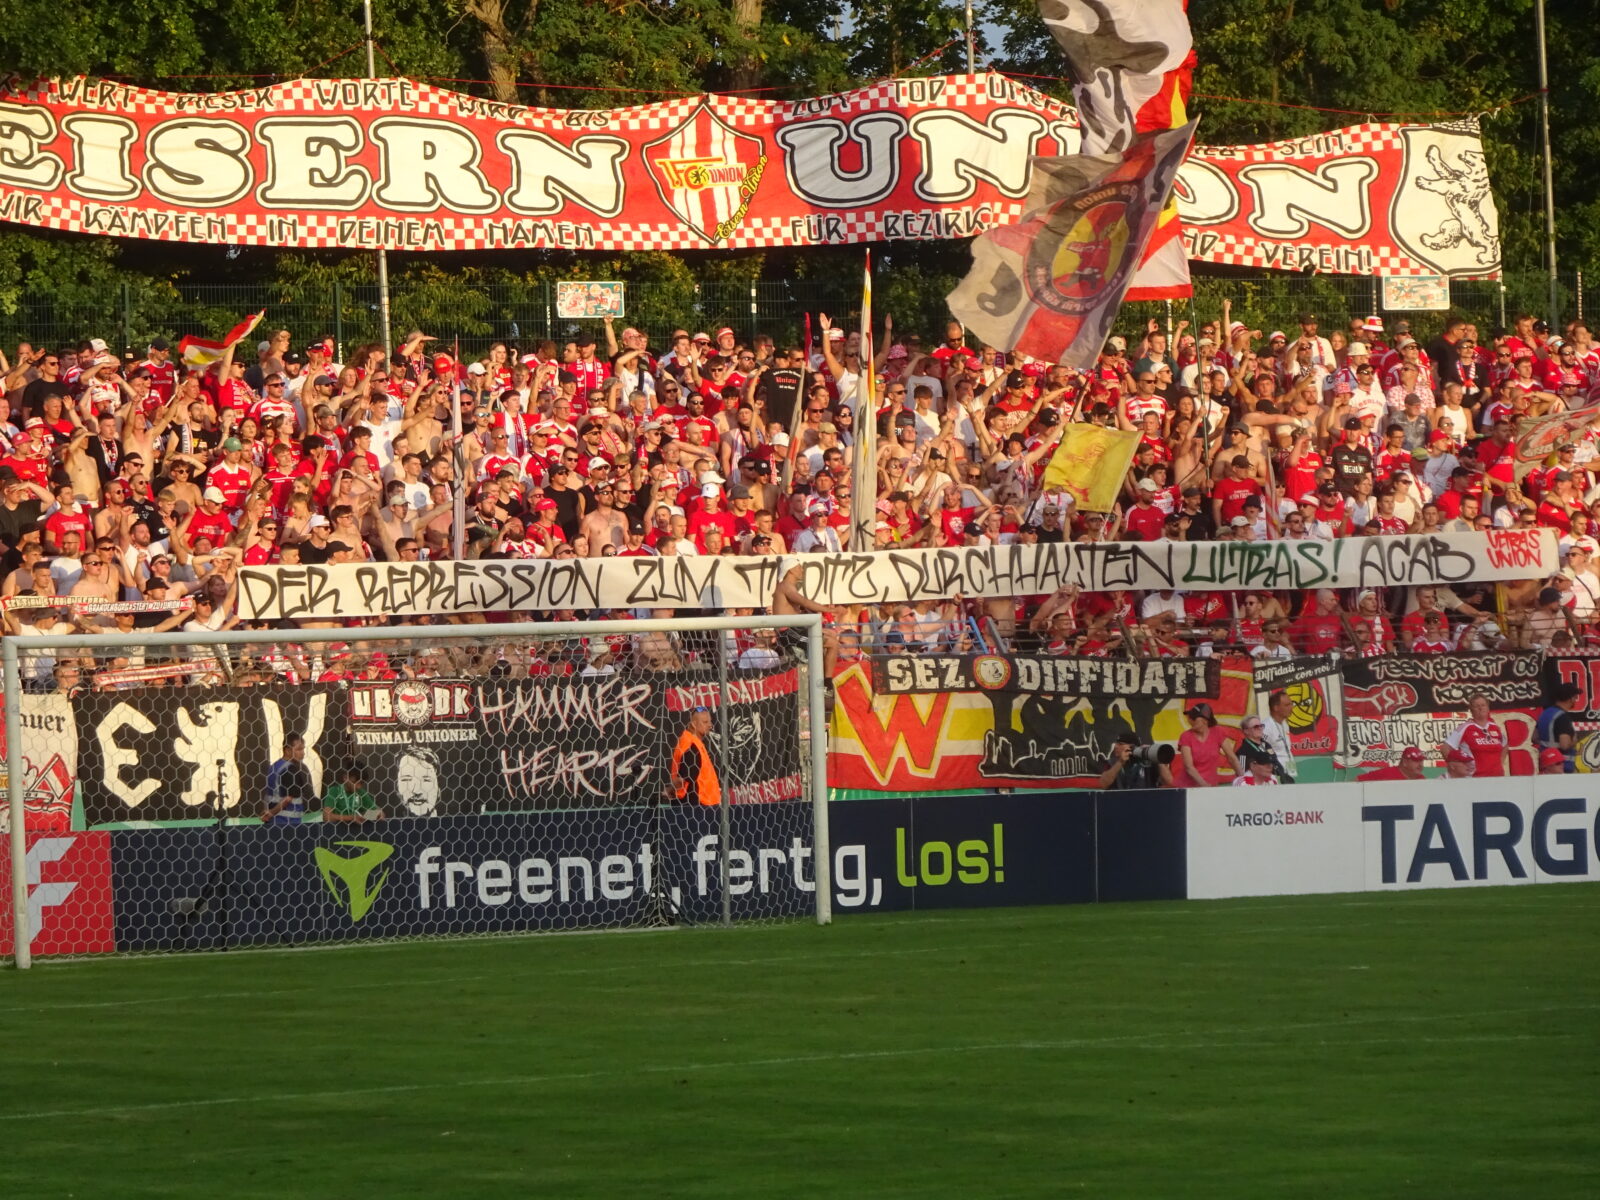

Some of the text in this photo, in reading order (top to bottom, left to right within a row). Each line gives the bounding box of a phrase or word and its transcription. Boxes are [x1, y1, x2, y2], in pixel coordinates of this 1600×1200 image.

[58, 78, 131, 108] WERT
[316, 81, 414, 107] WORTE
[566, 111, 612, 128] BIS
[893, 79, 945, 103] TOD
[0, 102, 630, 218] EISERN
[710, 166, 745, 184] UNION
[84, 205, 226, 241] KÄMPFEN
[269, 219, 297, 242] IN
[340, 220, 445, 246] DEINEM
[489, 222, 594, 247] NAMEN
[792, 213, 845, 242] FÜR
[1261, 243, 1373, 272] VEREIN!
[1487, 528, 1541, 549] ULTRAS
[1487, 547, 1543, 568] UNION
[239, 566, 343, 618] DER
[356, 559, 602, 614] REPRESSION
[627, 557, 720, 606] ZUM
[1360, 535, 1475, 586] ACAB
[887, 658, 976, 691] SEZ.
[1014, 659, 1207, 695] DIFFIDATI
[1255, 662, 1296, 681] Diffidati
[1295, 671, 1314, 680] con
[478, 676, 656, 738] HAMMER
[355, 728, 478, 745] EINMAL UNIONER
[1348, 721, 1382, 746] EINS
[1385, 715, 1421, 747] FÜNF
[501, 745, 654, 801] HEARTS
[1361, 797, 1600, 885] TARG
[693, 834, 882, 907] fertg,
[896, 823, 1006, 888] los!
